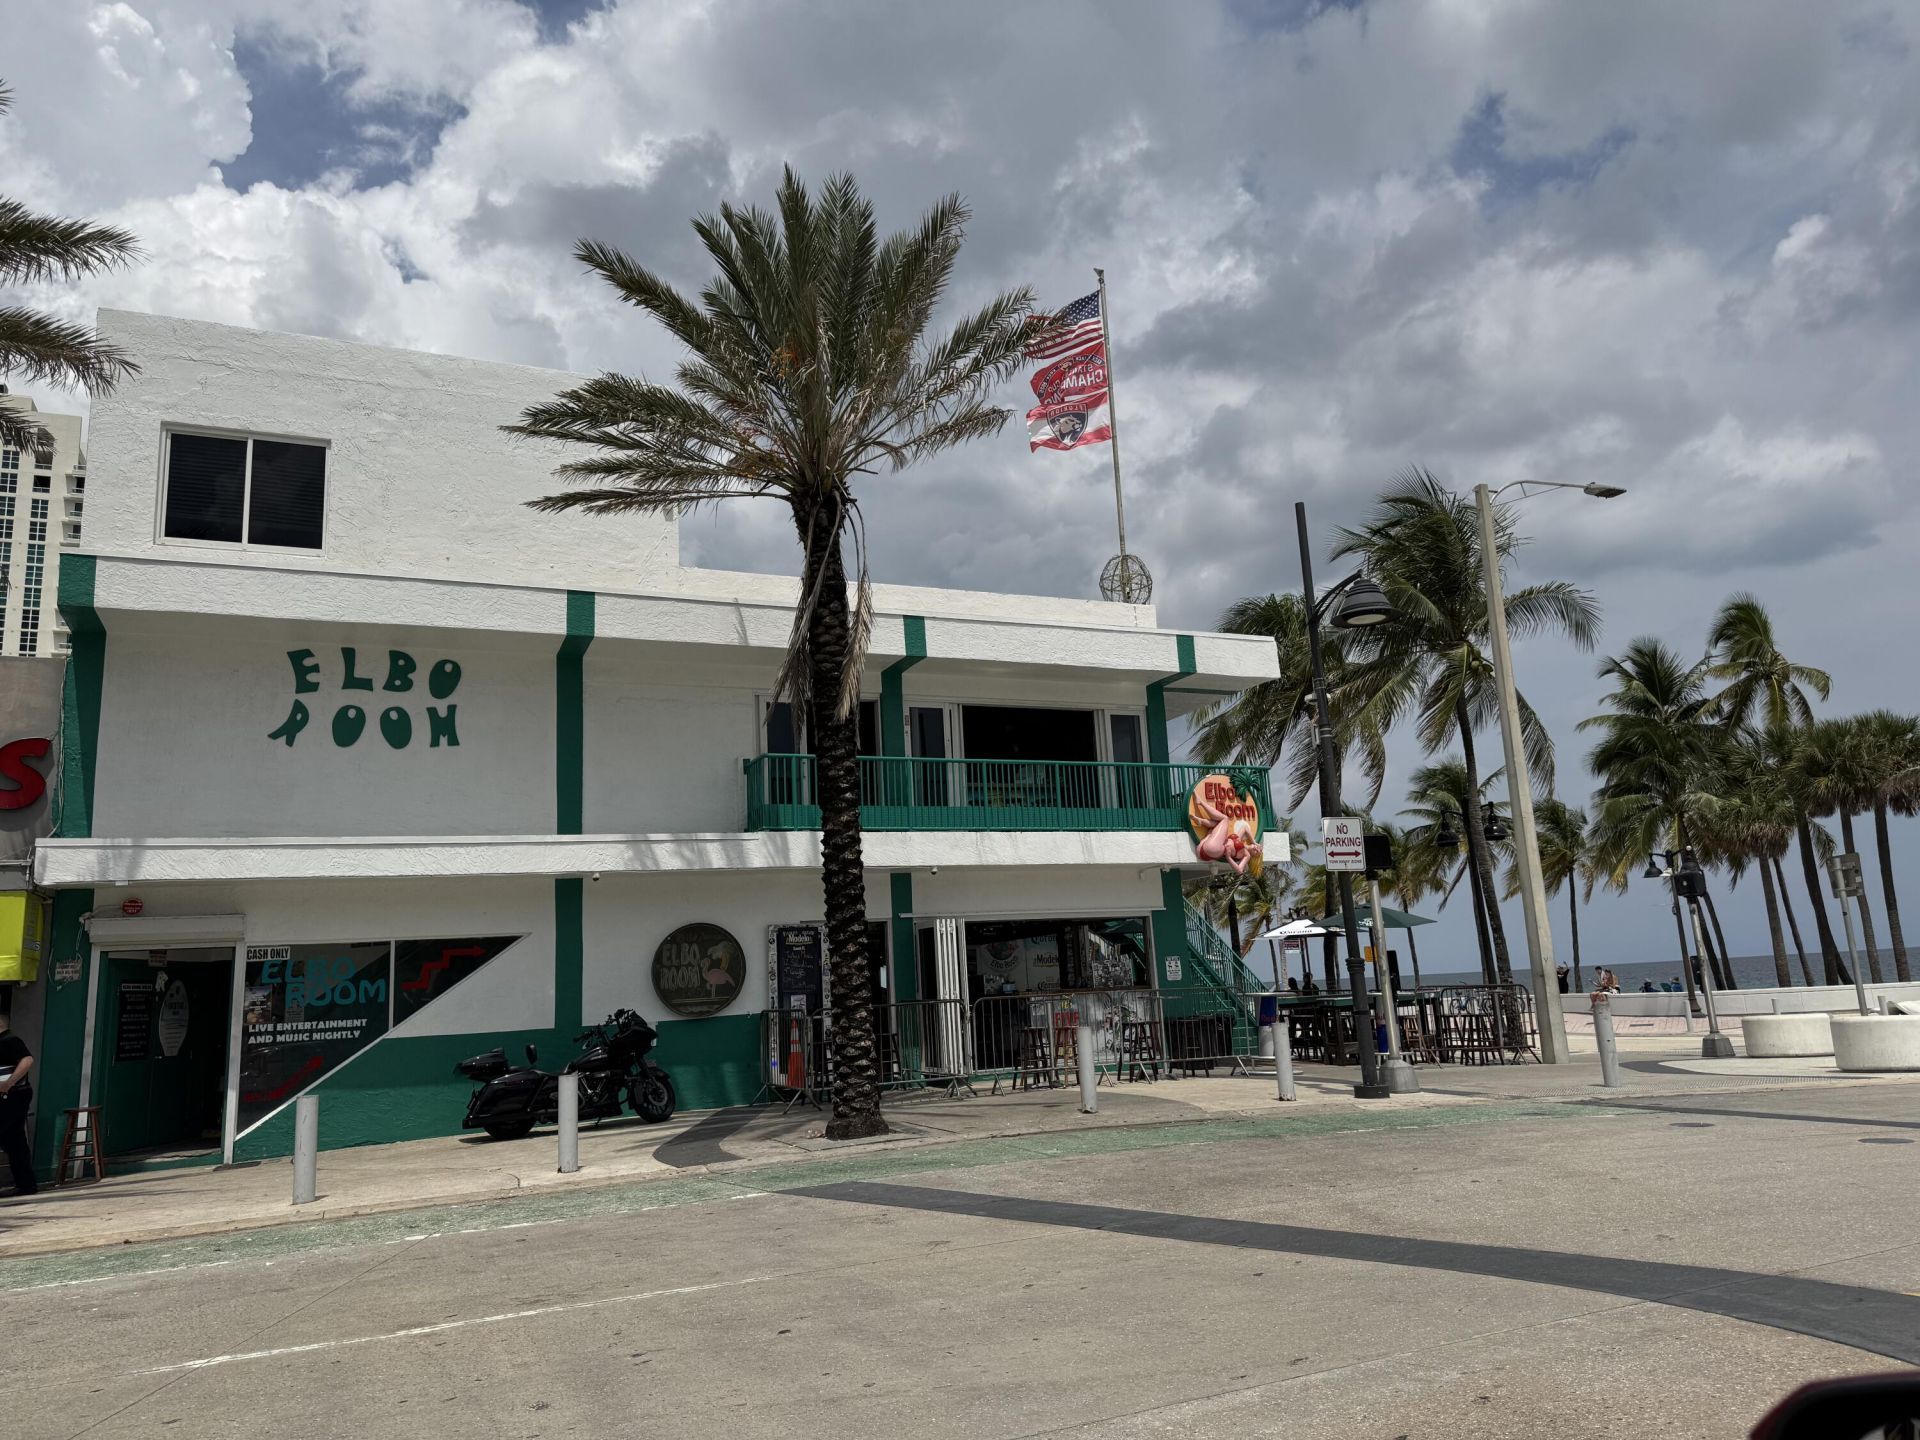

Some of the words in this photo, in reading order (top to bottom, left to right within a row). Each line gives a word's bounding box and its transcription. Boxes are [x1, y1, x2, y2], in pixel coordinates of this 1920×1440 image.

[287, 646, 462, 699] ELBO
[267, 698, 461, 750] ROOM
[1205, 782, 1235, 801] Elbo
[1216, 800, 1256, 819] Room
[1336, 824, 1349, 835] NO
[1325, 836, 1361, 847] PARKING
[788, 934, 811, 943] Modelo
[247, 948, 269, 960] CASH
[270, 947, 289, 959] ONLY
[662, 943, 700, 967] ELBO
[262, 956, 356, 984] ELBO
[660, 966, 701, 991] ROOM
[285, 978, 386, 1009] ROOM
[248, 1022, 275, 1033] LIVE
[276, 1018, 368, 1031] ENTERTAINMENT
[248, 1034, 274, 1045] AND
[276, 1031, 310, 1043] MUSIC
[312, 1029, 361, 1041] NIGHTLY
